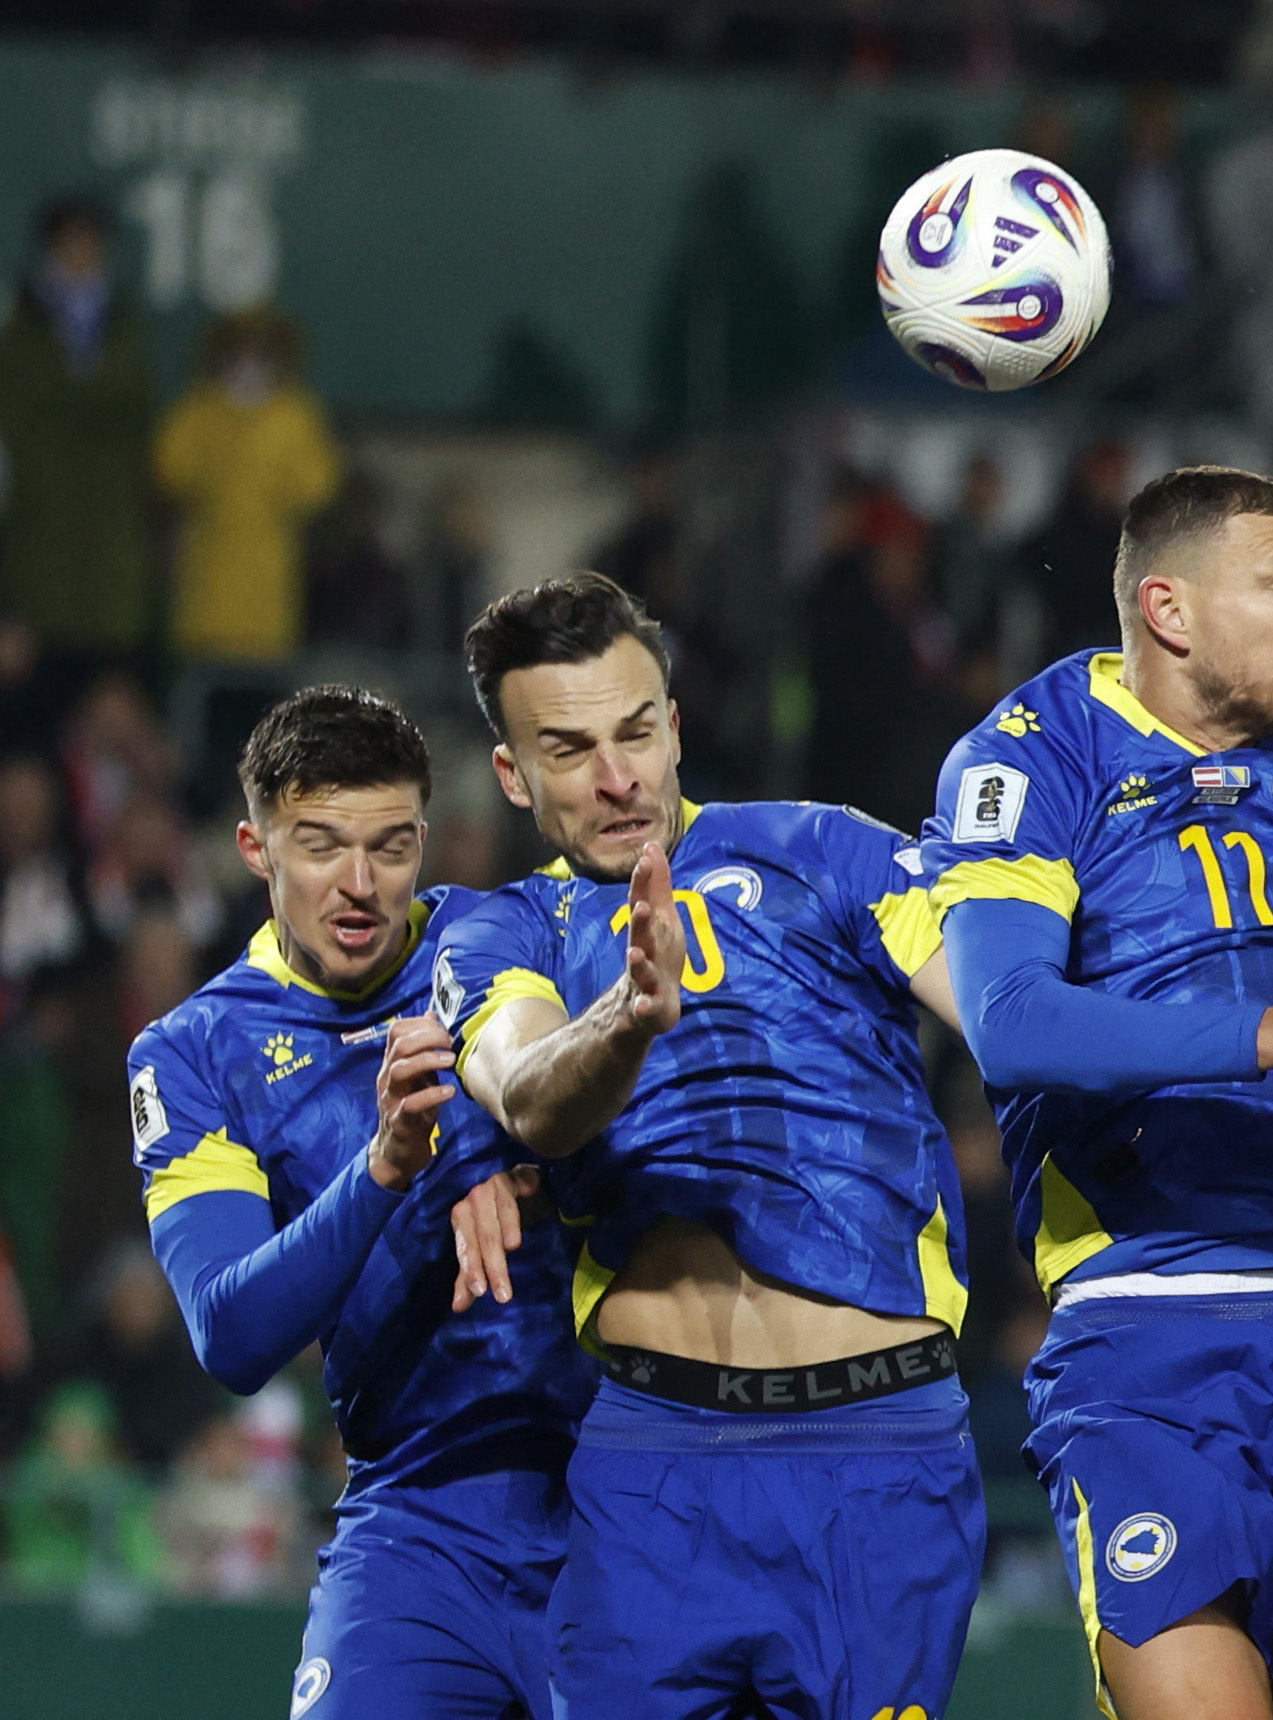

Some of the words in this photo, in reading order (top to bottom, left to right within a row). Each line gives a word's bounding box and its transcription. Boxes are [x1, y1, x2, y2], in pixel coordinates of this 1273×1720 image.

[1108, 795, 1158, 816] KELME
[265, 1052, 314, 1085] KELME
[717, 1345, 932, 1405] KELME
